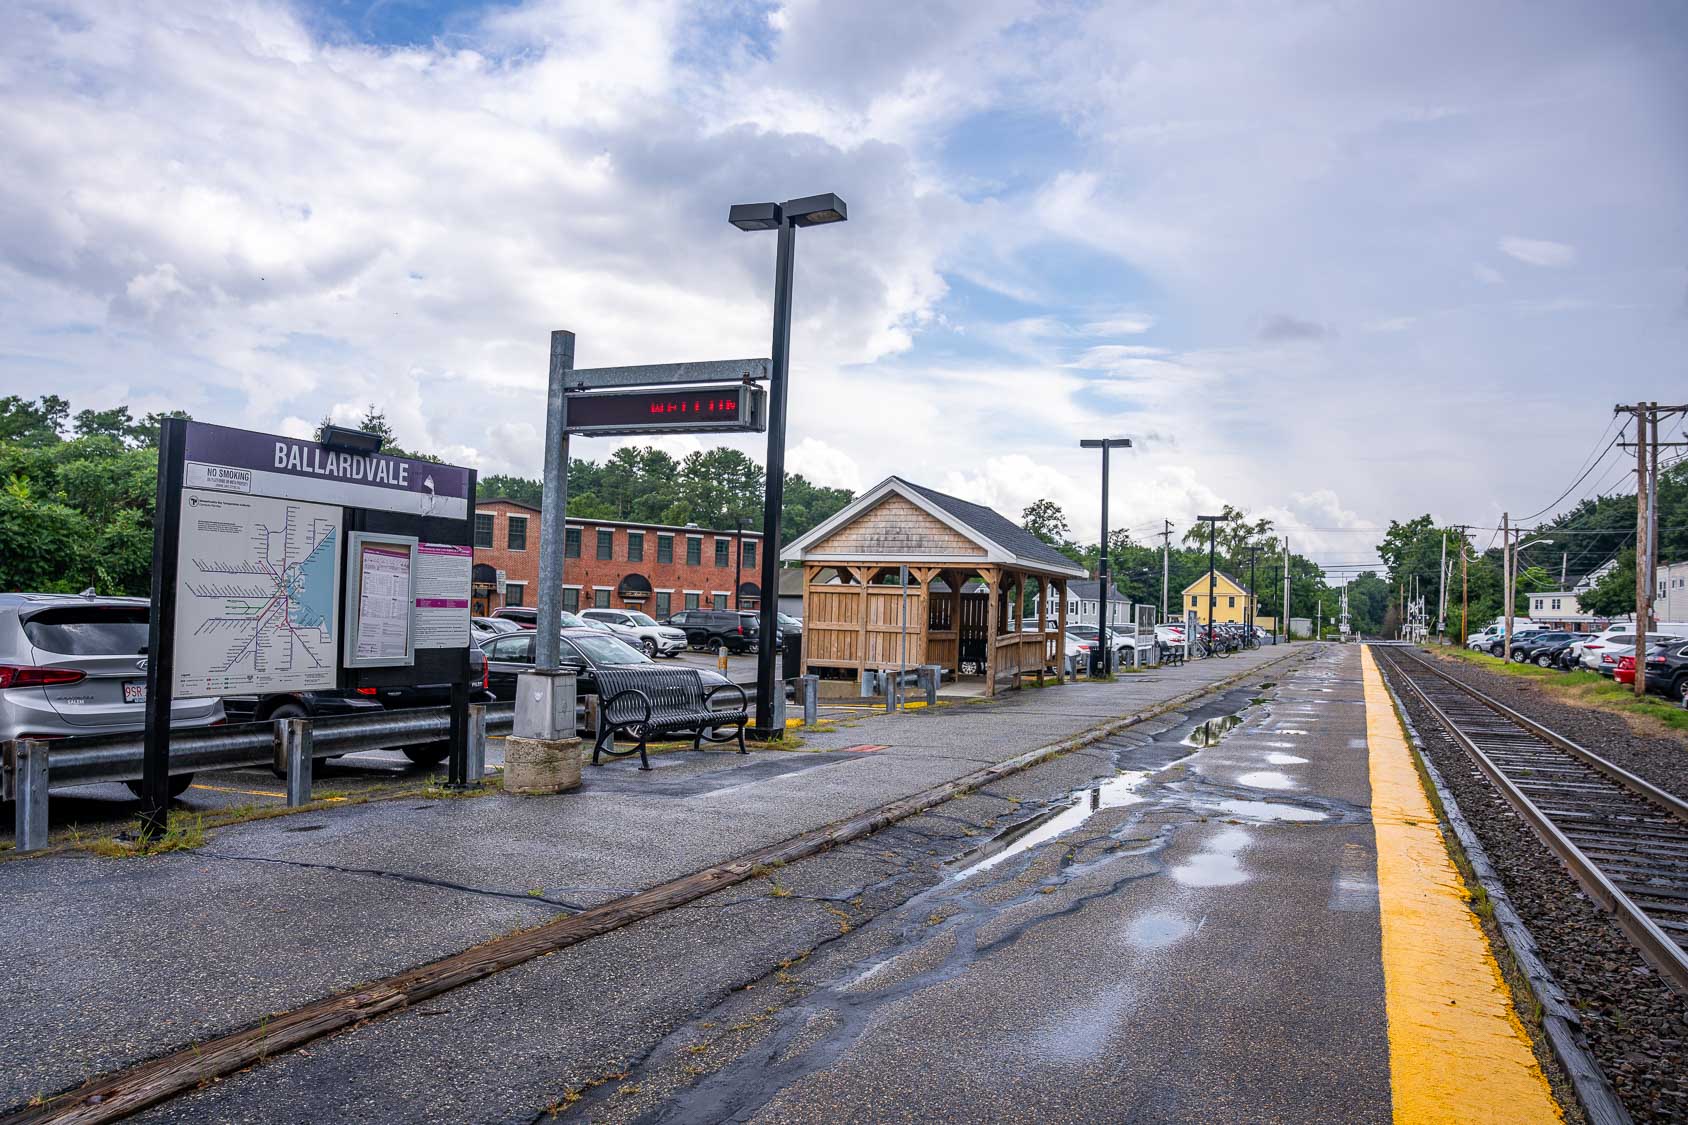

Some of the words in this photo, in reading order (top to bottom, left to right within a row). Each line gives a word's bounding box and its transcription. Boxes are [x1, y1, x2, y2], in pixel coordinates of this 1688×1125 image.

[207, 467, 217, 477] NO
[219, 469, 250, 481] SMOKING
[274, 442, 409, 486] BALLARDVALE
